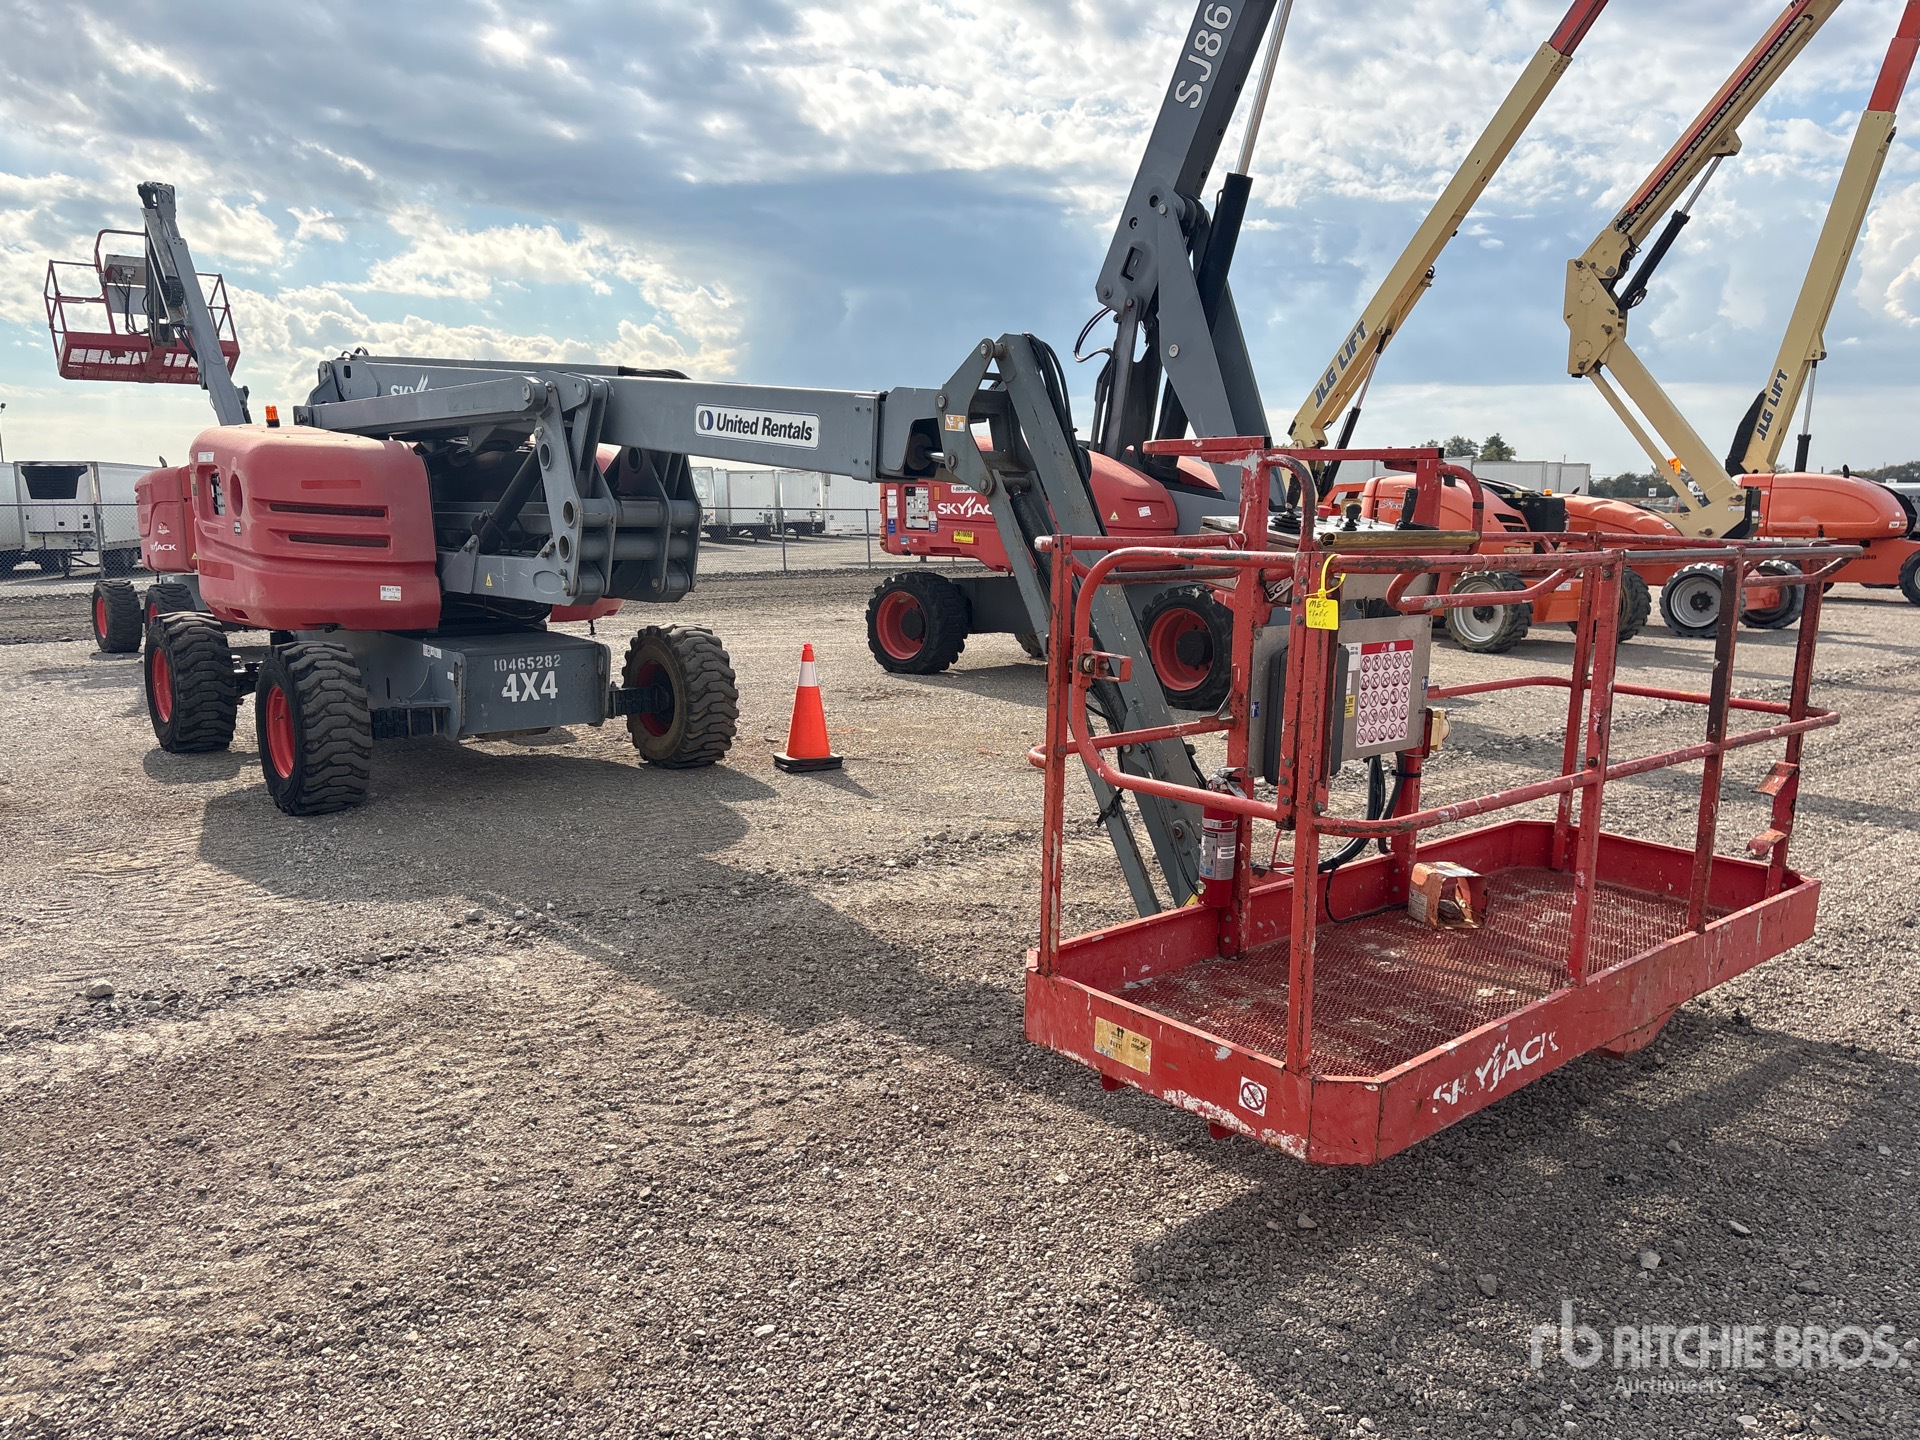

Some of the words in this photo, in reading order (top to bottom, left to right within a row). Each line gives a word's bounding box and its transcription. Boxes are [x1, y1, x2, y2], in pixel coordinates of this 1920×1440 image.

[1175, 3, 1232, 109] SJ86
[1315, 366, 1337, 410] JLG
[1338, 320, 1366, 371] LIFT
[1757, 408, 1774, 441] JLG
[1768, 368, 1788, 408] LIFT
[716, 412, 760, 436] United
[761, 417, 813, 441] Rentals
[937, 496, 993, 518] SKYJAC
[493, 654, 561, 673] 10465282
[501, 670, 559, 703] 4X4
